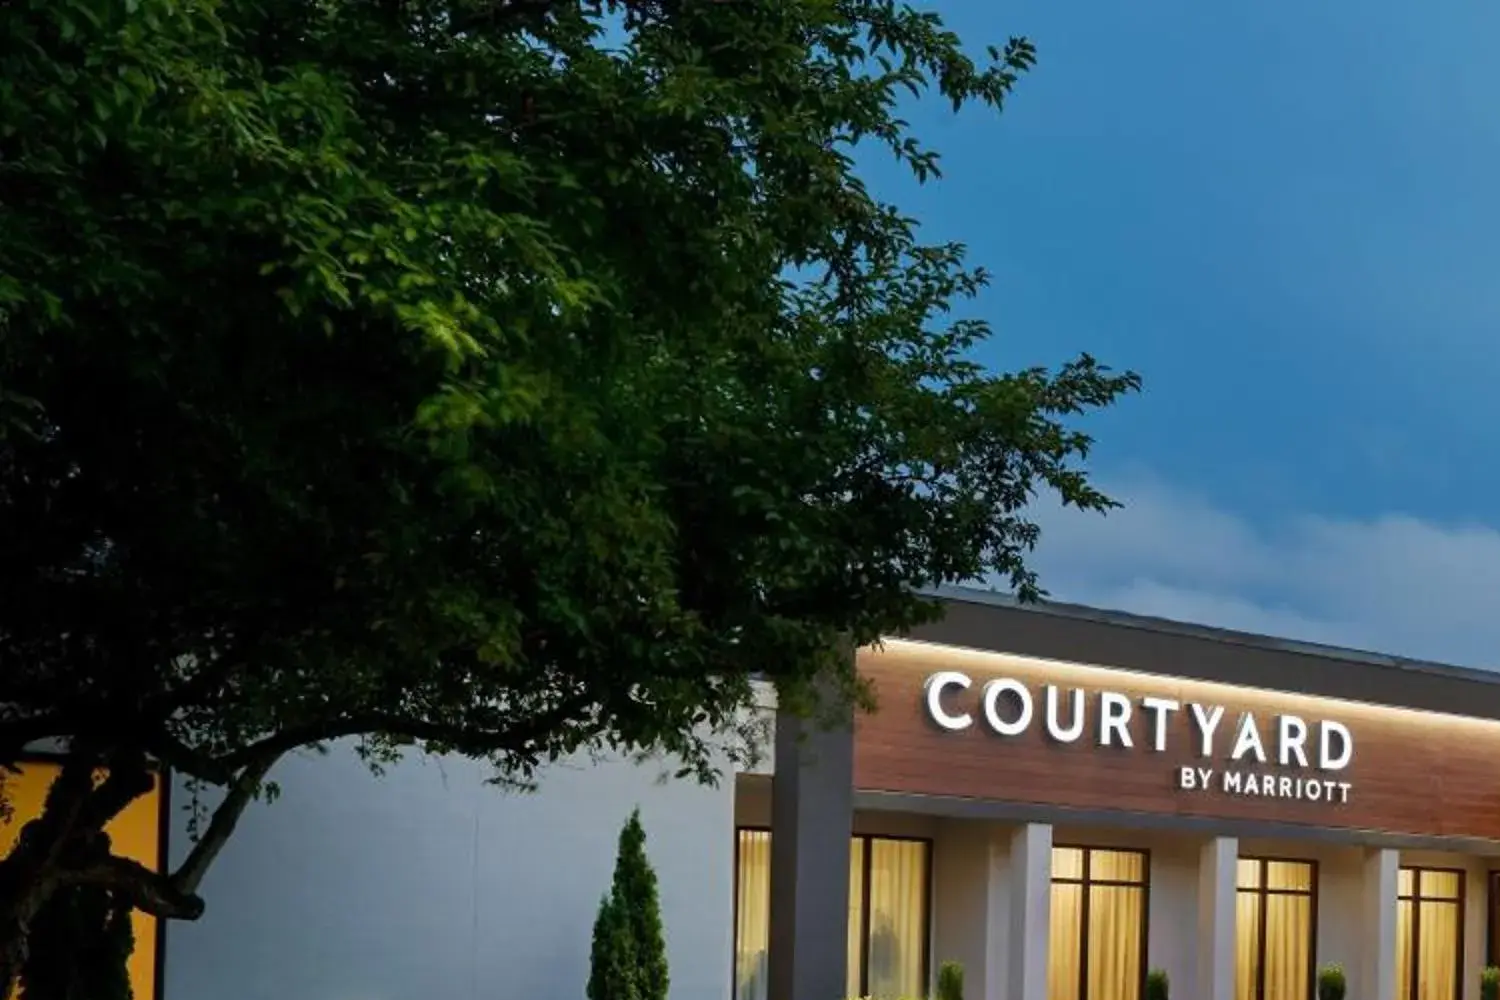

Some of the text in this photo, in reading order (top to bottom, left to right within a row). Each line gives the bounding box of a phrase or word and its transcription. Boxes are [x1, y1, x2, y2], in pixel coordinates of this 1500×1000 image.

[925, 671, 1354, 770] COURTYARD
[1180, 766, 1352, 803] BY MARRIOTT
